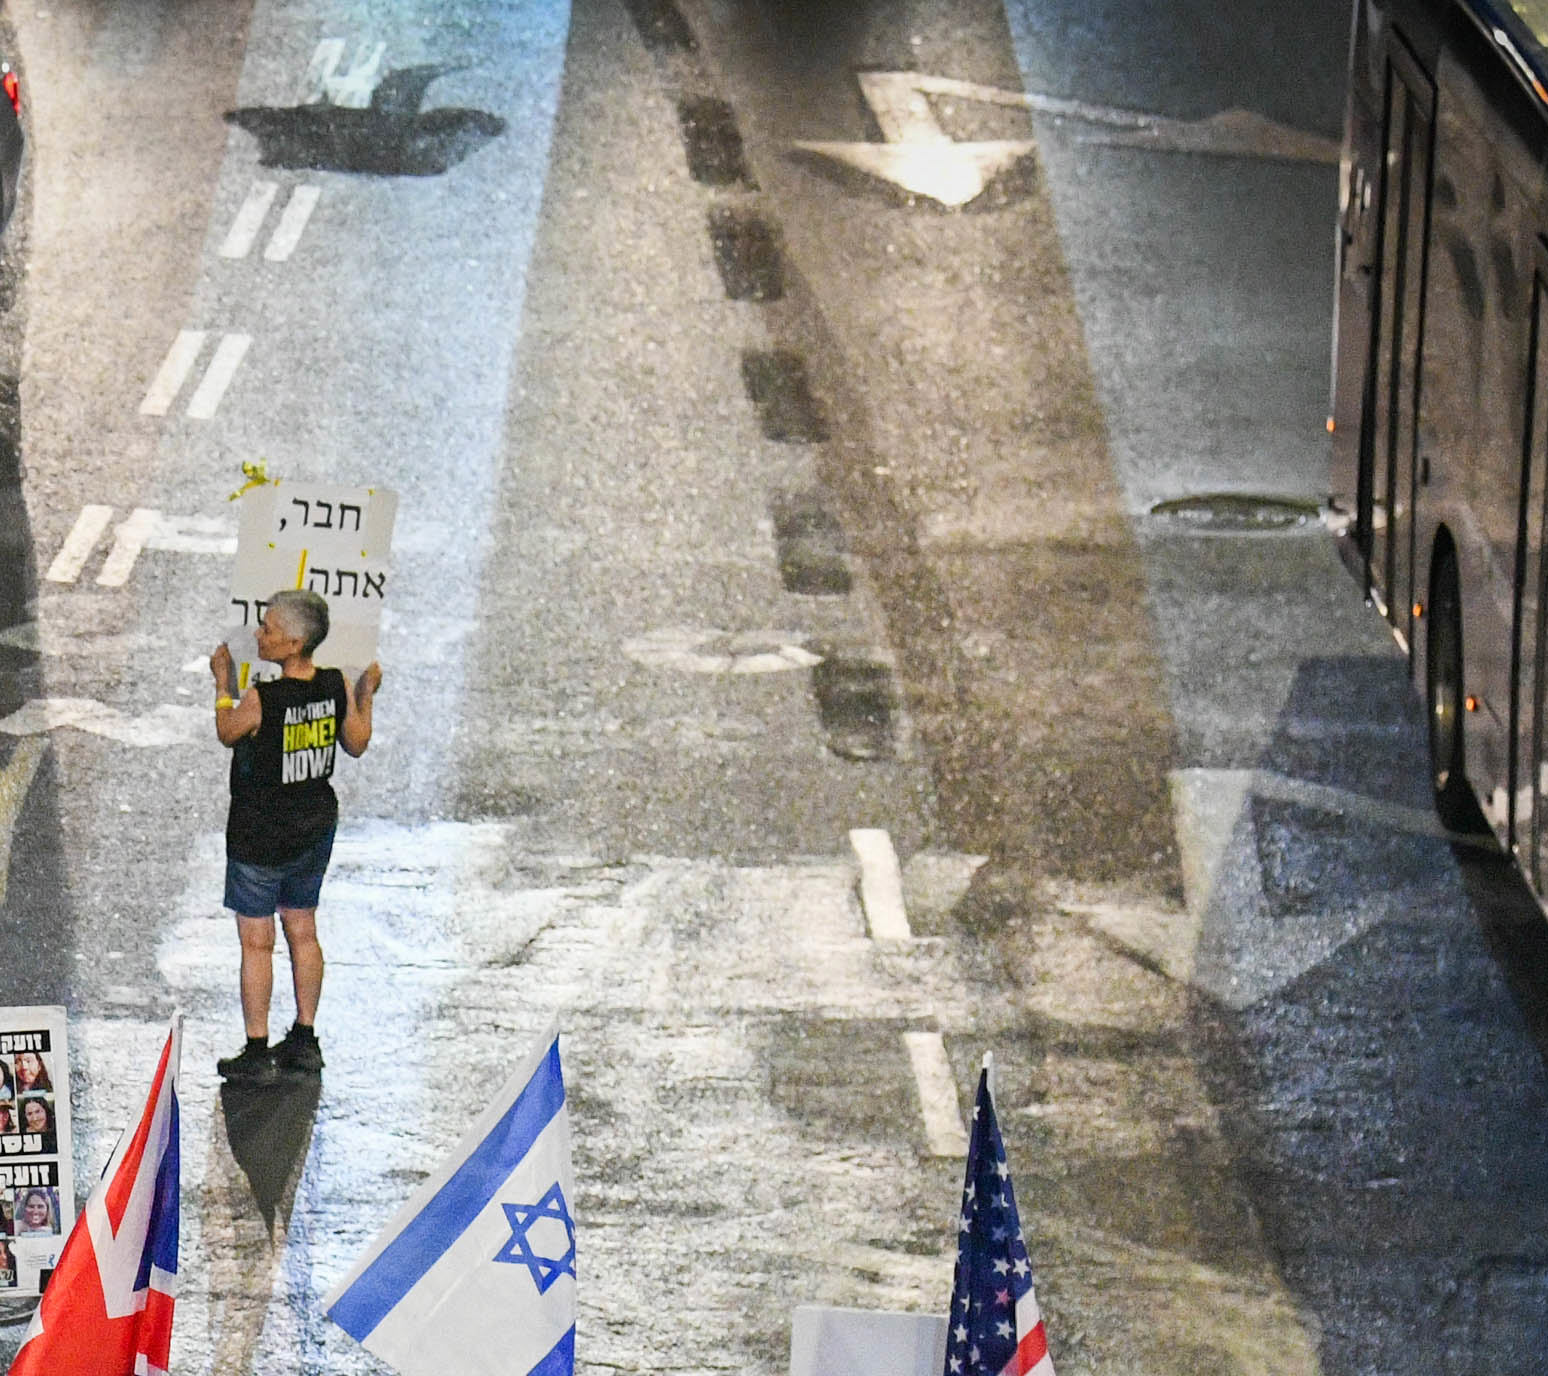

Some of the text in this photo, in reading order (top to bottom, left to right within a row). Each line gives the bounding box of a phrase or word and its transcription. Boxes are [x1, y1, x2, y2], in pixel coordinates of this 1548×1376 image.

[279, 498, 362, 532] חבר,
[308, 567, 387, 600] אתה
[307, 699, 335, 721] THEM
[283, 716, 336, 752] HOME!
[282, 746, 334, 784] NOW!
